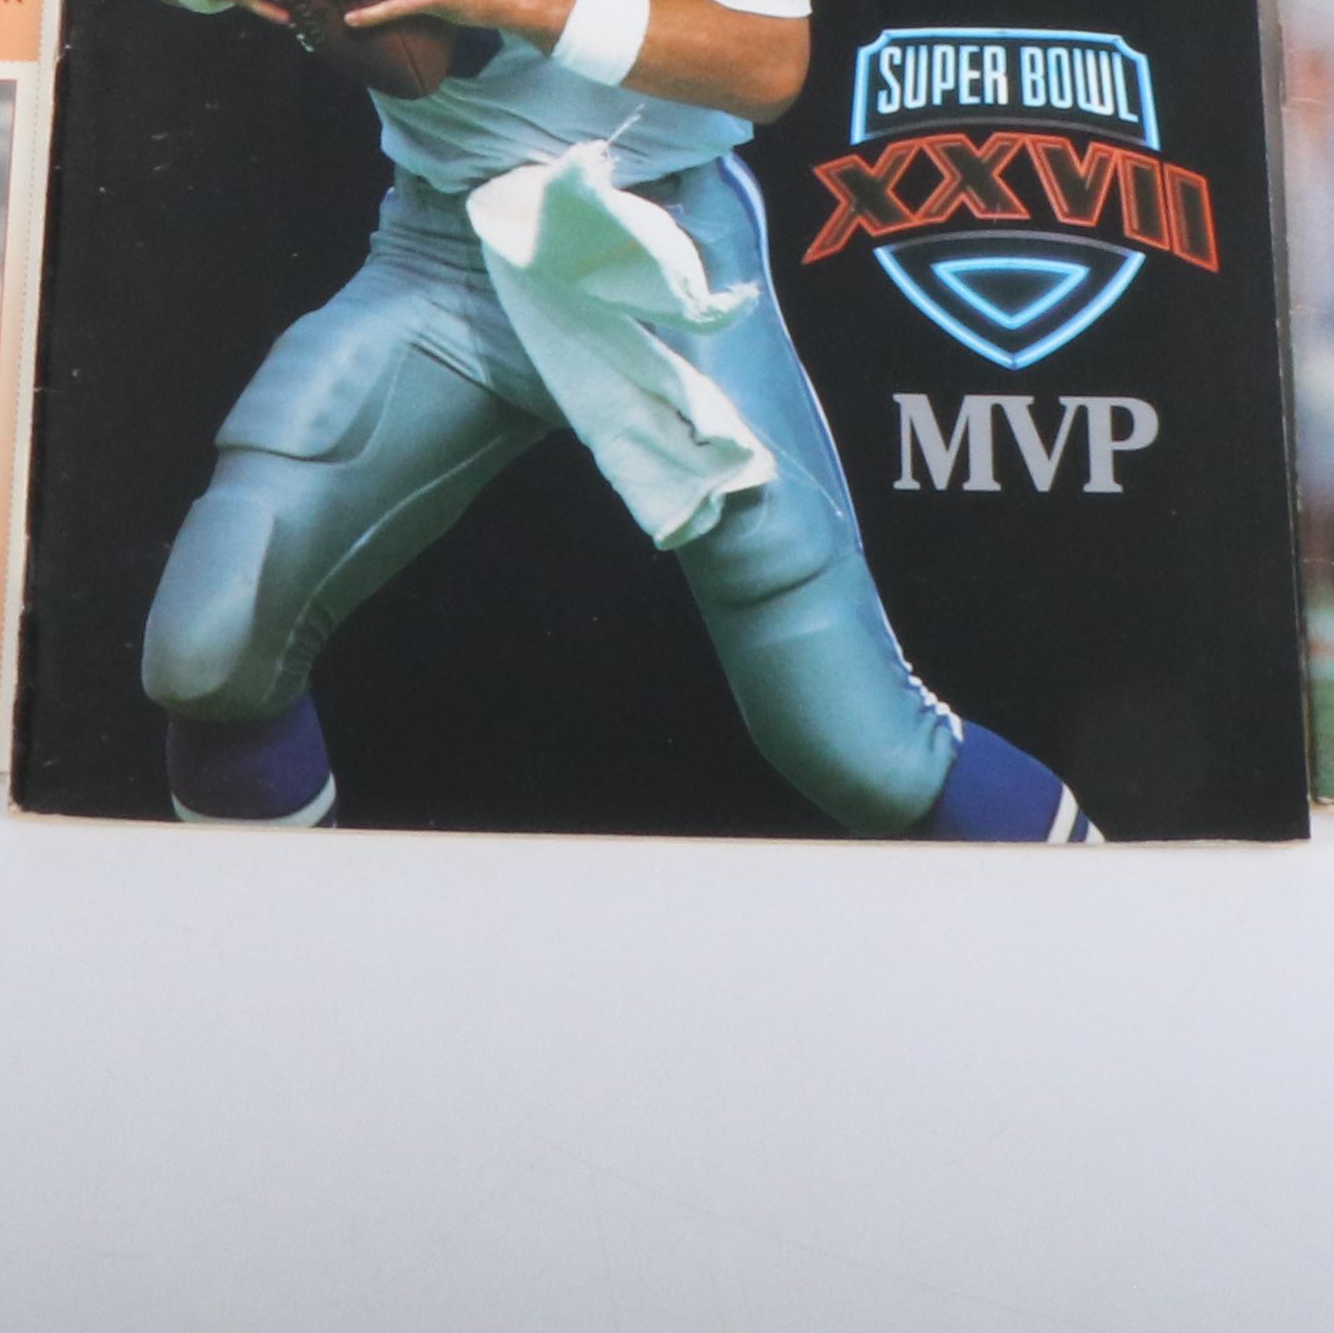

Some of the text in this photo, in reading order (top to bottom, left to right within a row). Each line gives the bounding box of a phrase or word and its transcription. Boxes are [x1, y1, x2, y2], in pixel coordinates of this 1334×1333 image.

[876, 43, 1140, 123] SUPER BOWL
[801, 132, 1220, 273] XXVII
[892, 392, 1160, 494] MVP
